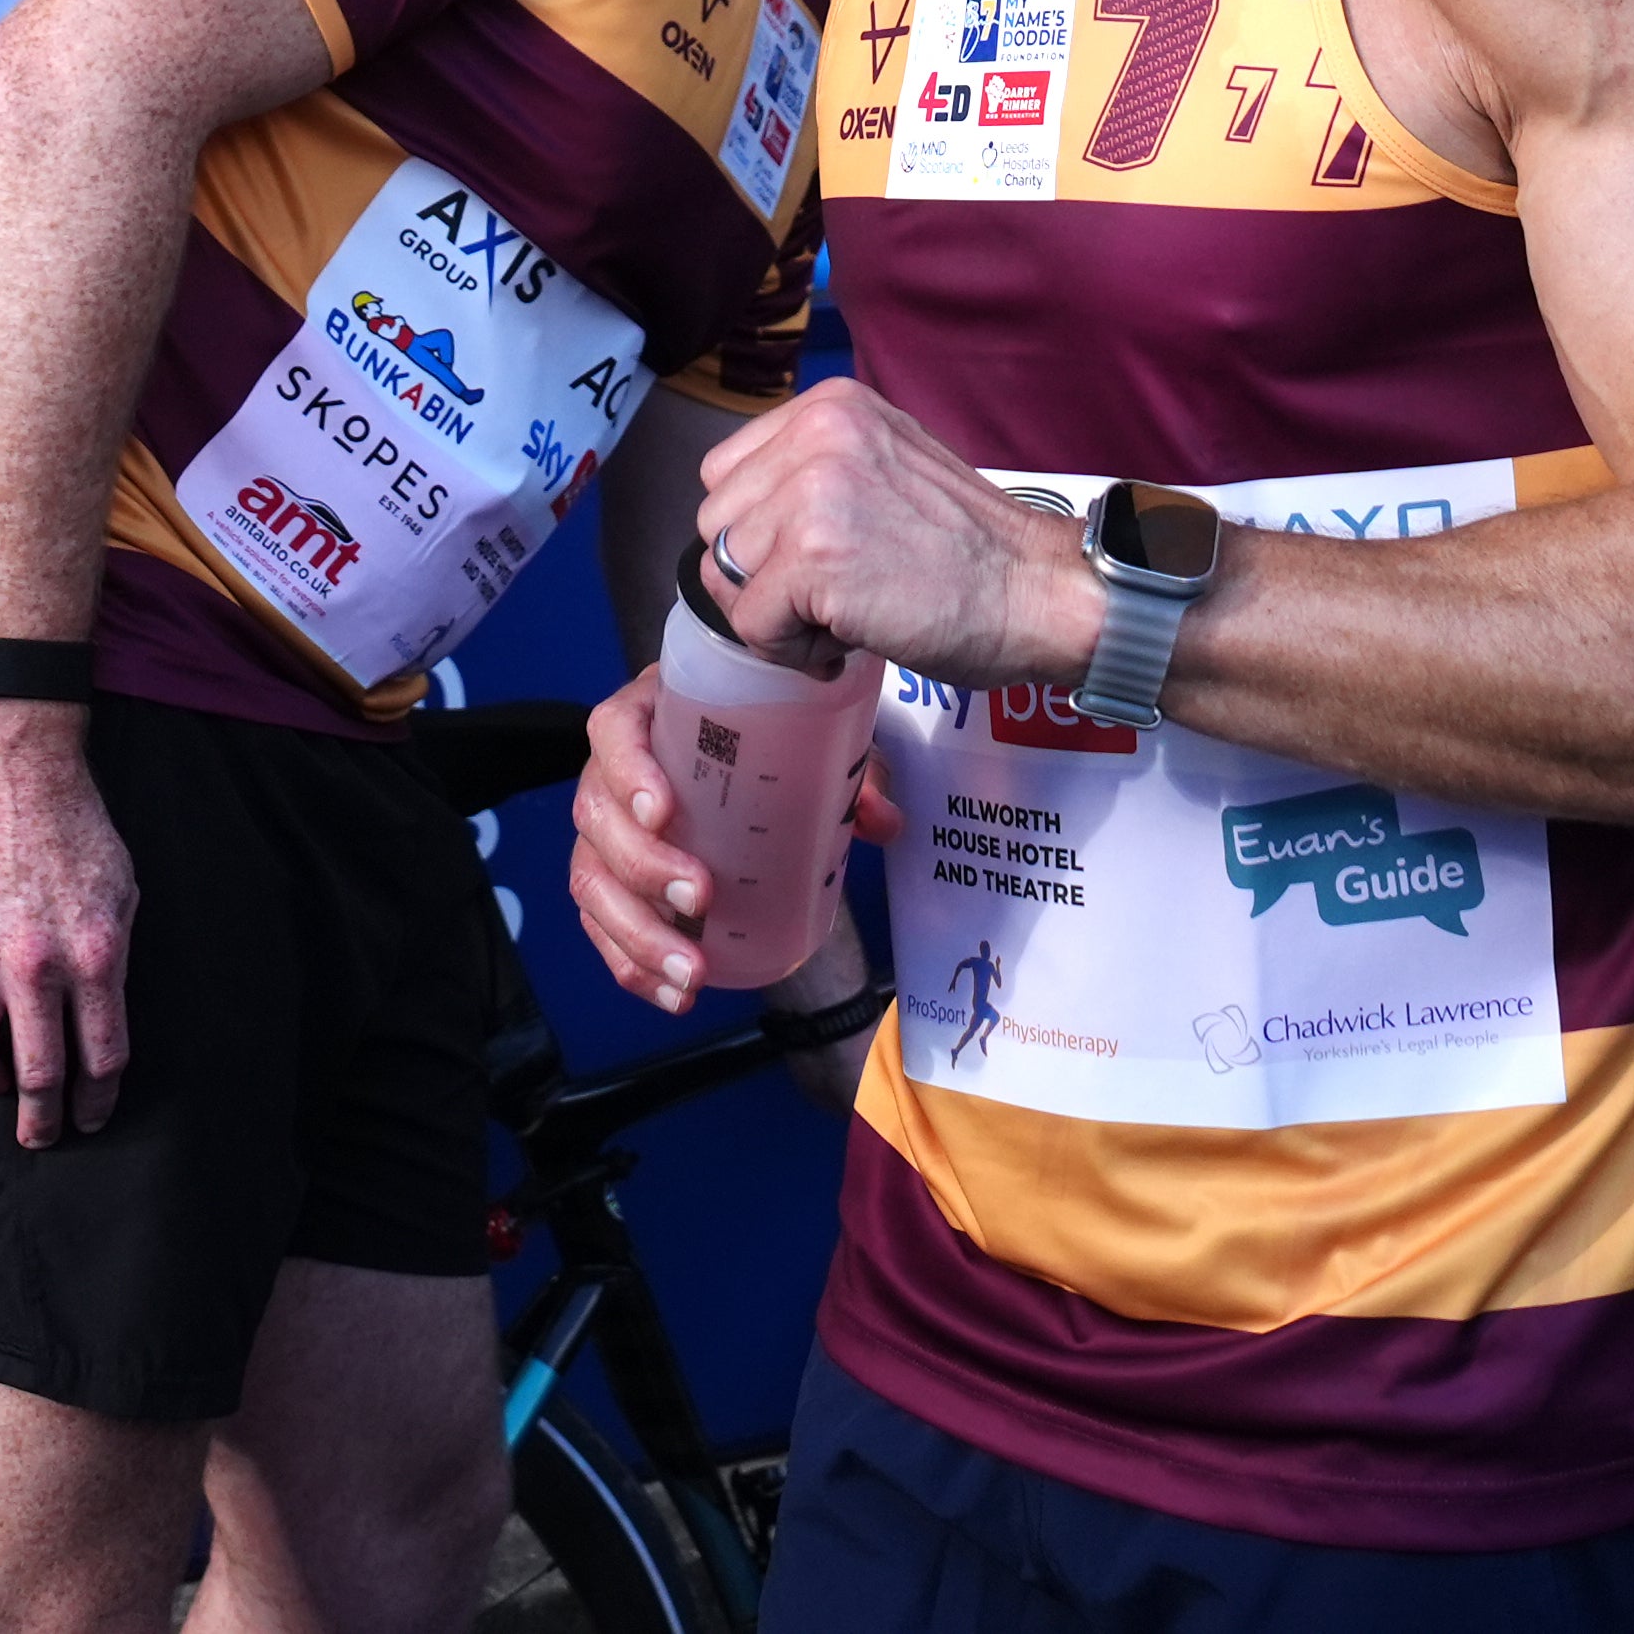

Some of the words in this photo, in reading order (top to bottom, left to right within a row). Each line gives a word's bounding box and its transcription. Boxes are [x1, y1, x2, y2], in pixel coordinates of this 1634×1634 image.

[1003, 29, 1068, 47] DODDIE
[1004, 10, 1065, 28] NAME'S
[661, 21, 716, 81] OXEN
[1000, 52, 1065, 62] FOUNDATION
[917, 71, 972, 122] 4ED
[1002, 99, 1041, 111] RIMMER
[1003, 86, 1037, 99] DARBY
[1225, 65, 1278, 143] 7
[839, 106, 897, 140] OXEN
[919, 161, 964, 174] Scotland
[921, 141, 947, 156] MND
[1000, 142, 1029, 154] Leeds
[1003, 157, 1050, 170] Hospitals
[1004, 173, 1043, 189] Charity
[399, 228, 478, 292] GROUP
[416, 189, 556, 308] AXIS
[325, 307, 474, 444] BUNKABIN
[276, 365, 449, 520] SKOPES
[225, 504, 333, 599] amtauto.co.uk
[237, 476, 363, 586] amt
[215, 519, 245, 546] vehicle
[245, 545, 280, 576] solution
[280, 574, 292, 586] for
[291, 586, 327, 617] everyone
[948, 794, 1061, 834] KILWORTH
[932, 825, 1001, 858] HOUSE
[1007, 840, 1085, 872] HOTEL
[1232, 814, 1386, 866] Euan's
[933, 860, 977, 887] AND
[983, 869, 1085, 907] THEATRE
[1335, 854, 1464, 904] Guide
[908, 994, 966, 1026] ProSport
[1263, 1002, 1396, 1044] Chadwick
[1406, 996, 1533, 1027] Lawrence
[1003, 1016, 1118, 1058] Physiotherapy
[1303, 1036, 1391, 1063] Yorkshire's
[1398, 1033, 1439, 1055] Legal
[1444, 1029, 1499, 1050] People
